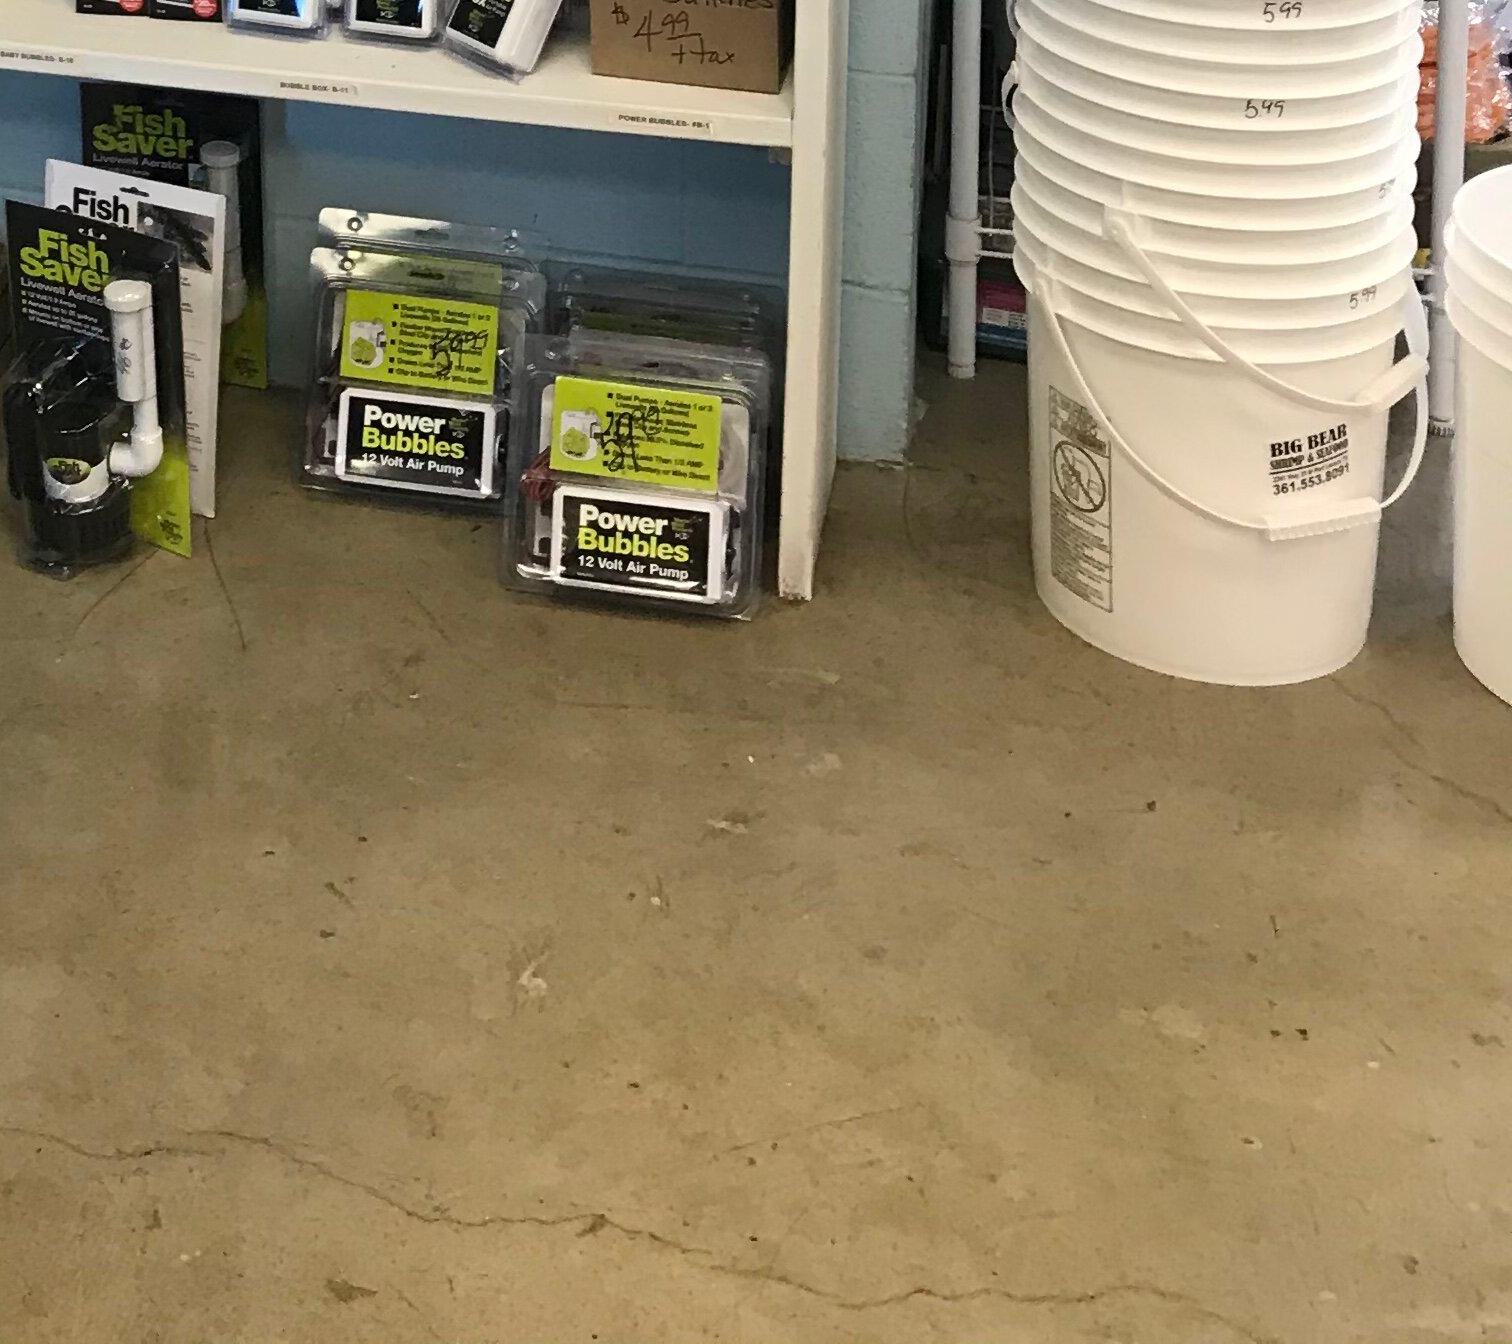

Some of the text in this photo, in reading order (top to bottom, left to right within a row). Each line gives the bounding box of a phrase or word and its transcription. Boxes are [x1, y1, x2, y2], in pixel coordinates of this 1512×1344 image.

[112, 103, 187, 137] Fish
[92, 122, 194, 159] Saver
[73, 187, 130, 226] Fish
[38, 227, 110, 274] Fish
[20, 276, 67, 297] Livewell
[363, 403, 446, 436] Power
[361, 426, 466, 460] Bubbles
[1270, 423, 1349, 459] BIG BEAR
[361, 452, 465, 477] 12 Volt Air Pump
[578, 503, 669, 536] Power
[577, 527, 690, 563] Bubbles
[577, 554, 690, 582] 12 Volt Air Pump
